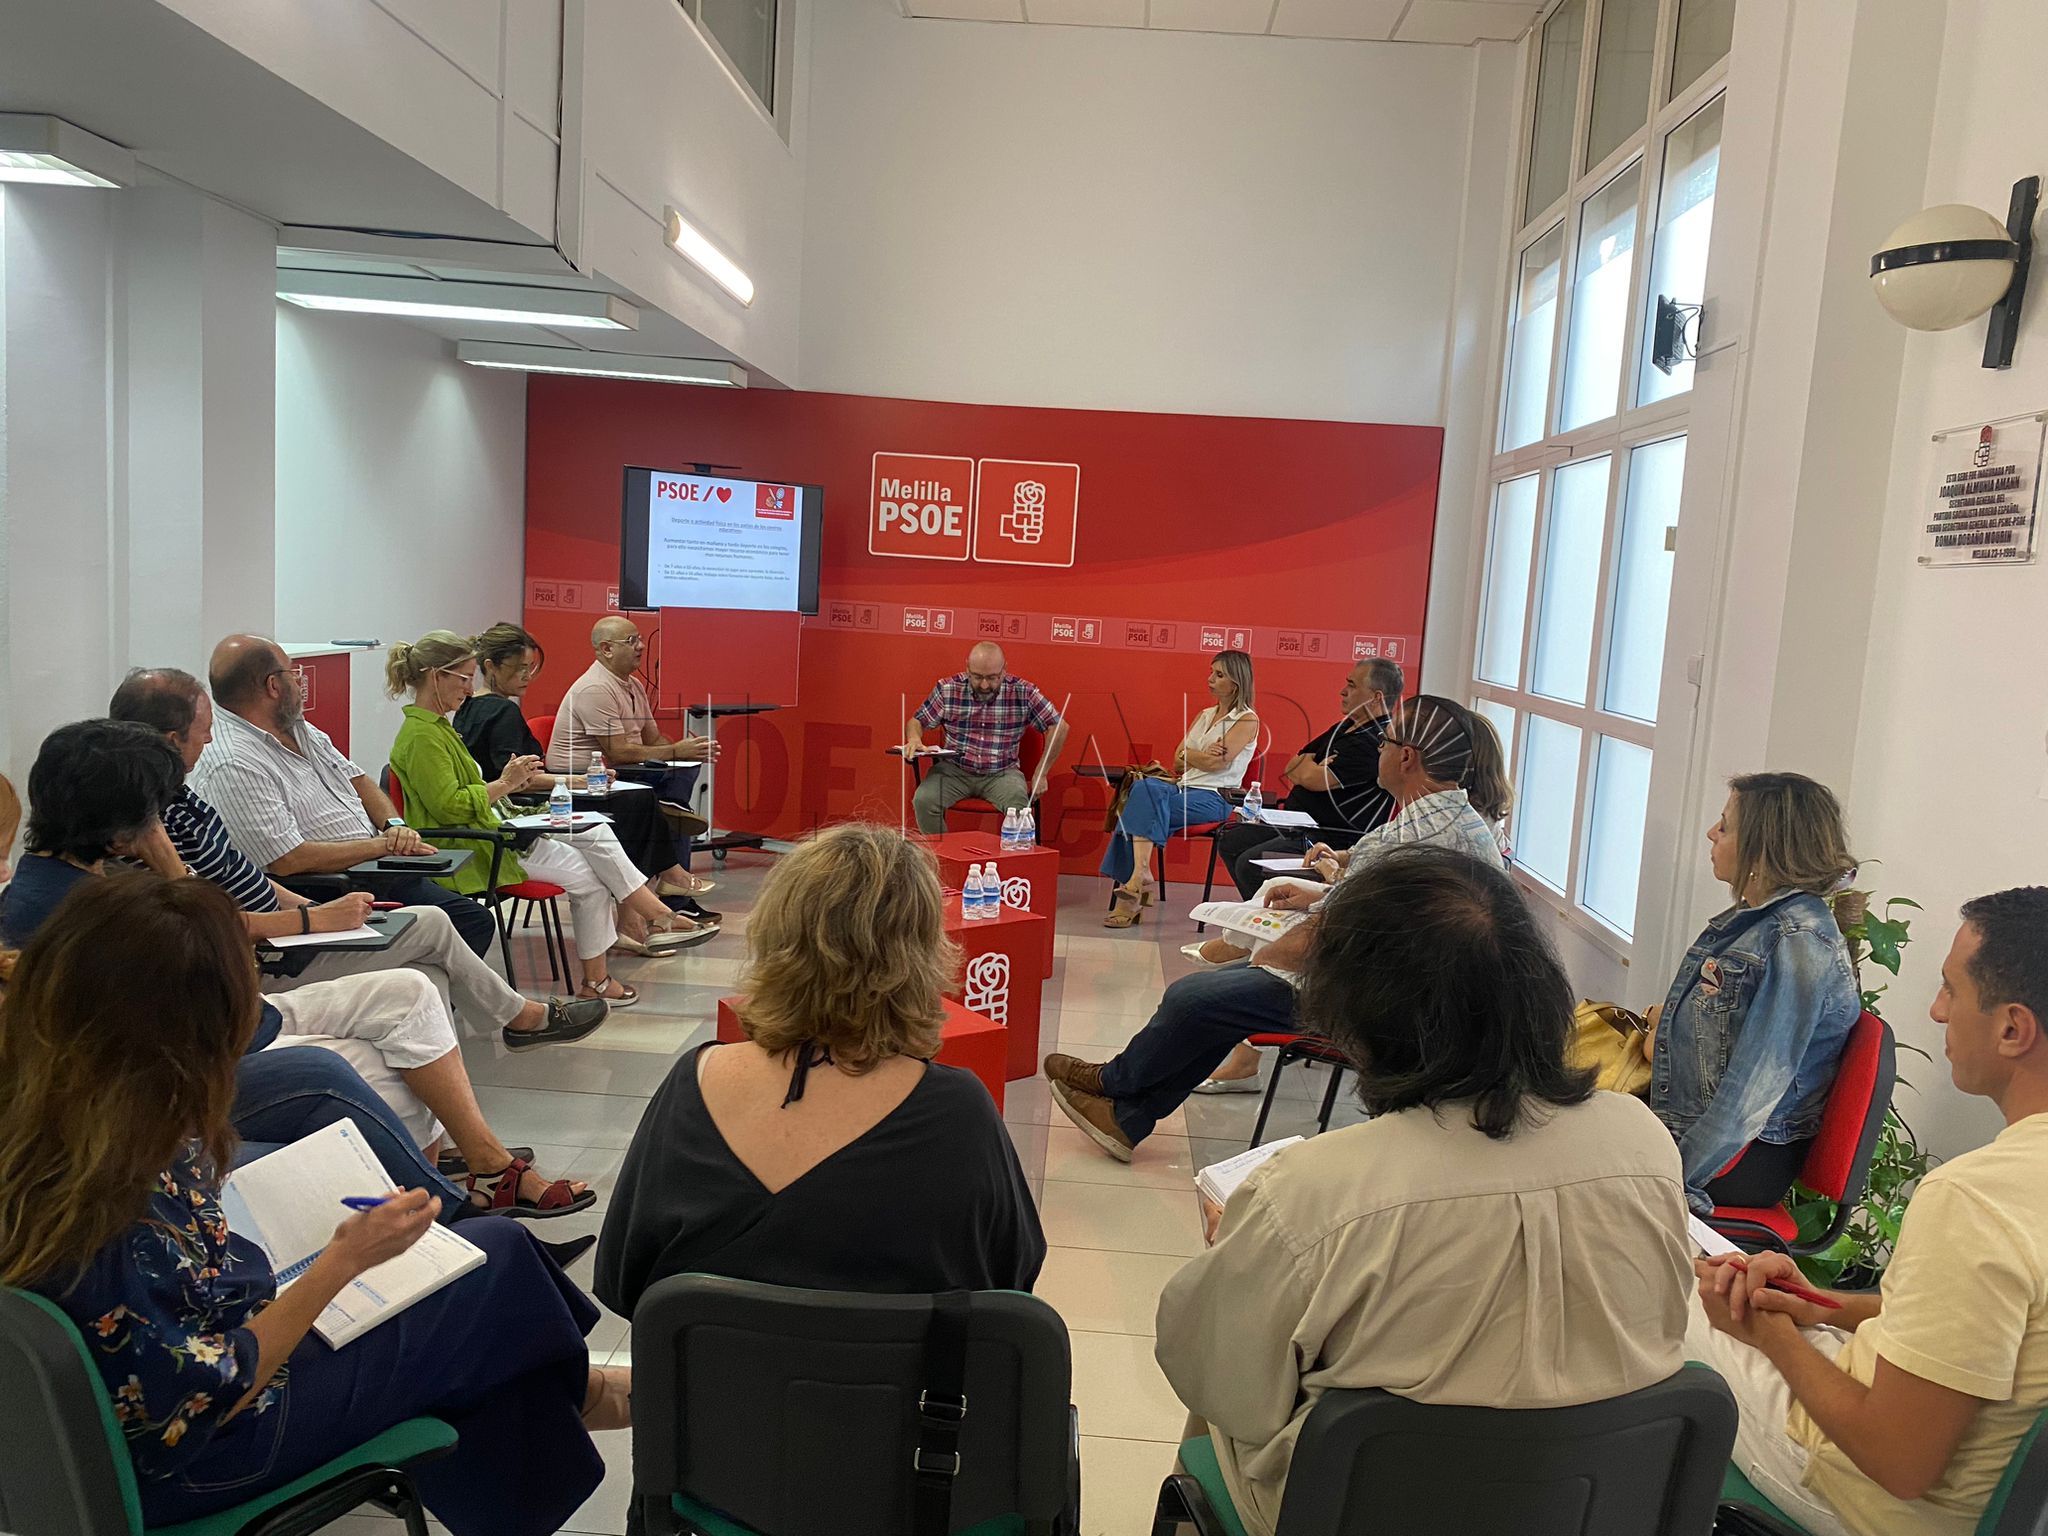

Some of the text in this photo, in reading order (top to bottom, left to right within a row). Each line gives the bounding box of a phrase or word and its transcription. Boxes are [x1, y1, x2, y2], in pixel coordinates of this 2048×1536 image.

[1946, 474, 1956, 483] ESTA
[1958, 472, 1968, 481] SEDE
[1969, 470, 1977, 480] FUE
[2005, 465, 2015, 474] POR
[657, 480, 699, 502] PSOE
[880, 478, 951, 501] Melilla
[1939, 482, 1966, 498] JOAQUIN
[1976, 495, 1996, 505] GENERAL
[1997, 494, 2005, 503] DEL
[1933, 511, 1952, 521] PARTIDO
[1952, 508, 1977, 519] SOCIALISTA
[1997, 503, 2019, 514] ESPAÑOL
[878, 501, 963, 537] PSOE
[1969, 520, 1989, 530] GENERAL
[1935, 535, 1957, 547] ROMAN
[535, 593, 555, 602] PSOE
[609, 598, 619, 606] PS
[832, 614, 852, 622] PSOE
[906, 619, 926, 627] PSOE
[980, 624, 1000, 632] PSOE
[1054, 629, 1074, 637] PSOE
[1128, 633, 1149, 642] PSOE
[1203, 638, 1224, 647] PSOE
[1279, 642, 1300, 651] PSOE
[1355, 647, 1376, 655] PSOE
